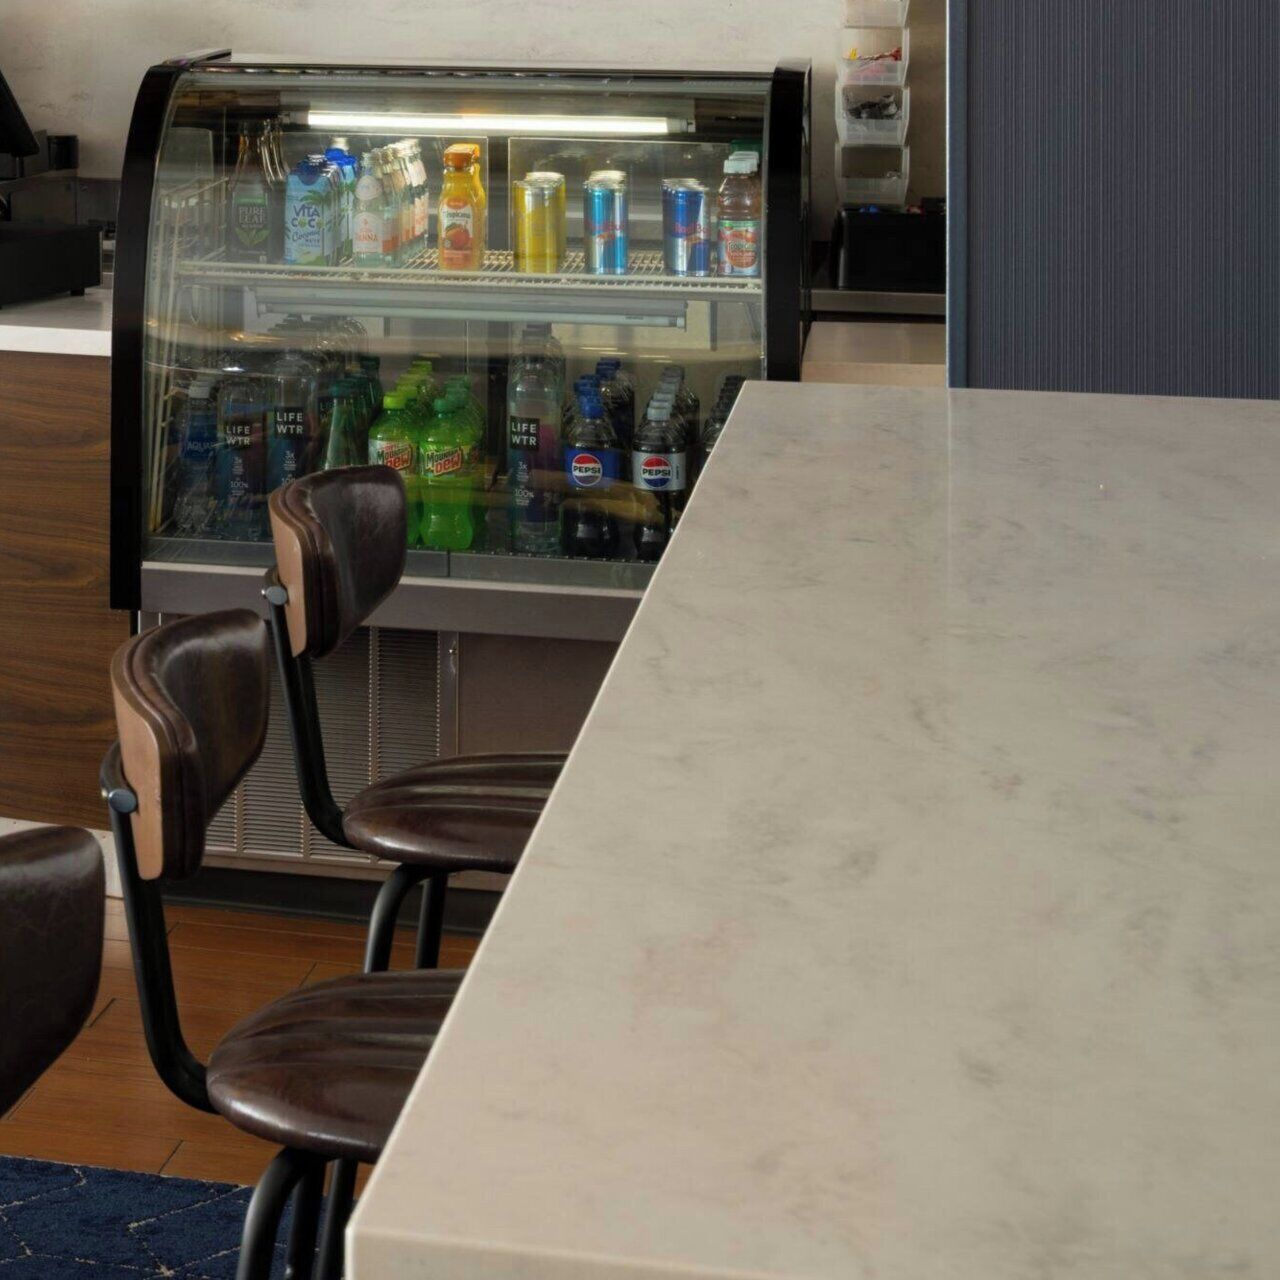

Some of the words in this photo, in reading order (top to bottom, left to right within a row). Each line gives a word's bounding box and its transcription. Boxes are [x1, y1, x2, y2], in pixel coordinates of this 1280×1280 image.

[292, 204, 320, 218] VITA
[276, 412, 304, 422] LIFE
[226, 426, 250, 434] LIFE
[276, 424, 304, 434] WTR
[511, 422, 537, 434] LIFE
[226, 436, 250, 446] WTR
[511, 436, 537, 446] WTR
[573, 465, 602, 475] PEPSI
[641, 466, 672, 477] PEPSI
